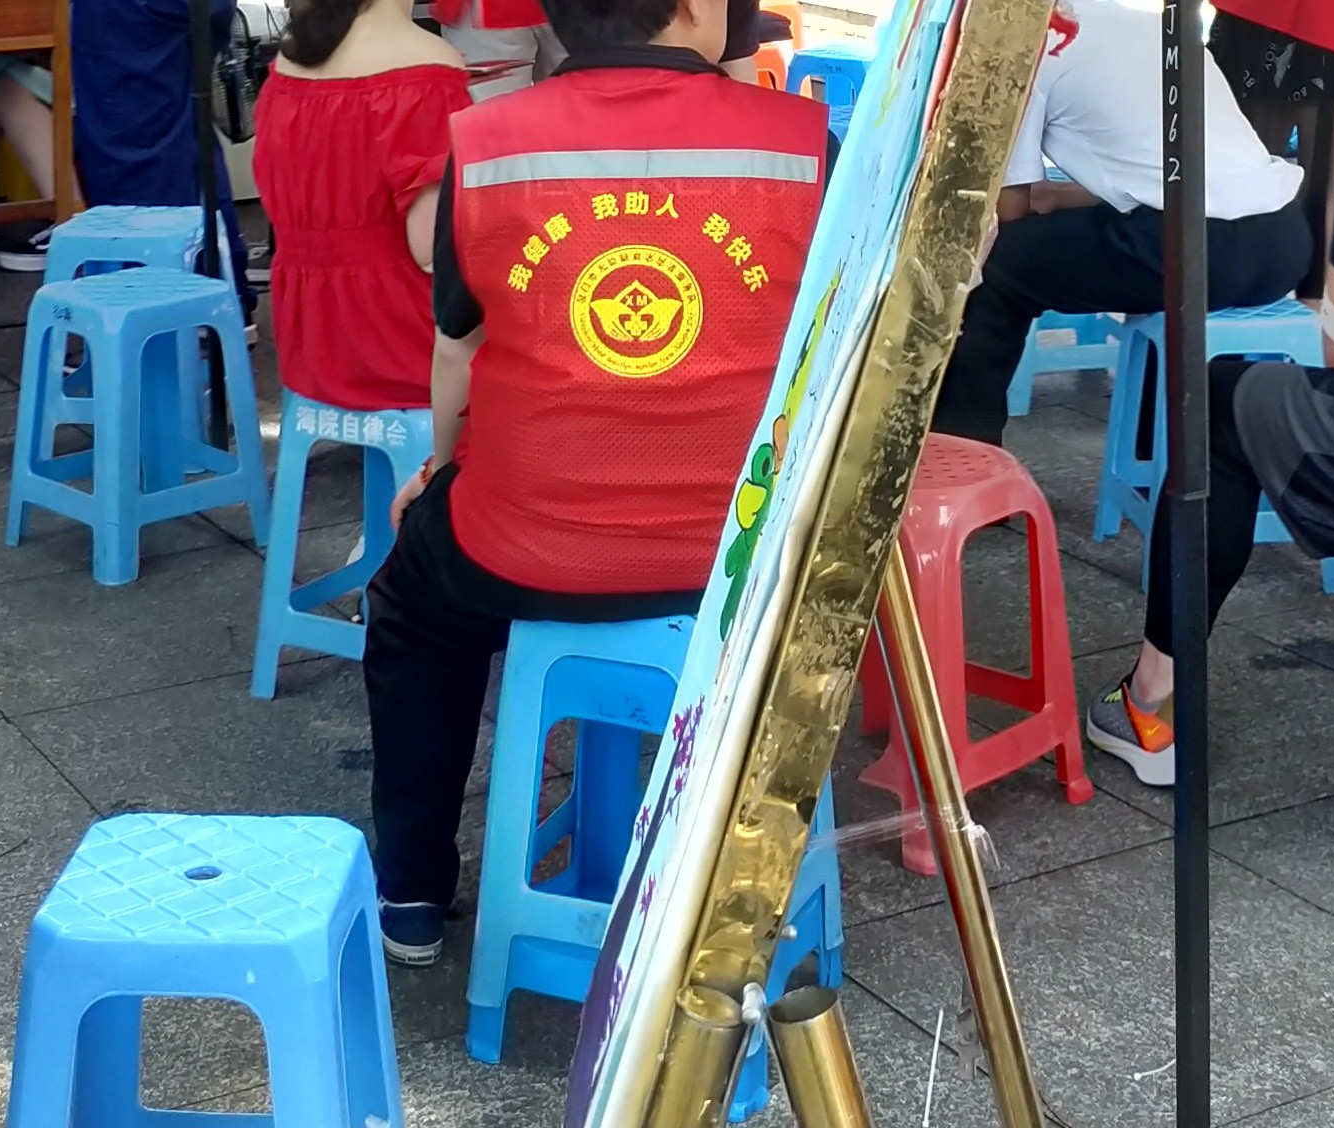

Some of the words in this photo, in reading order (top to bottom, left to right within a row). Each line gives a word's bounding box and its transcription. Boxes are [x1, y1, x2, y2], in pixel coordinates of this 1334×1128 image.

[507, 212, 573, 293] 我健康
[592, 191, 680, 220] 我助人
[701, 212, 769, 293] 我快乐
[296, 405, 408, 447] 海院自律会
